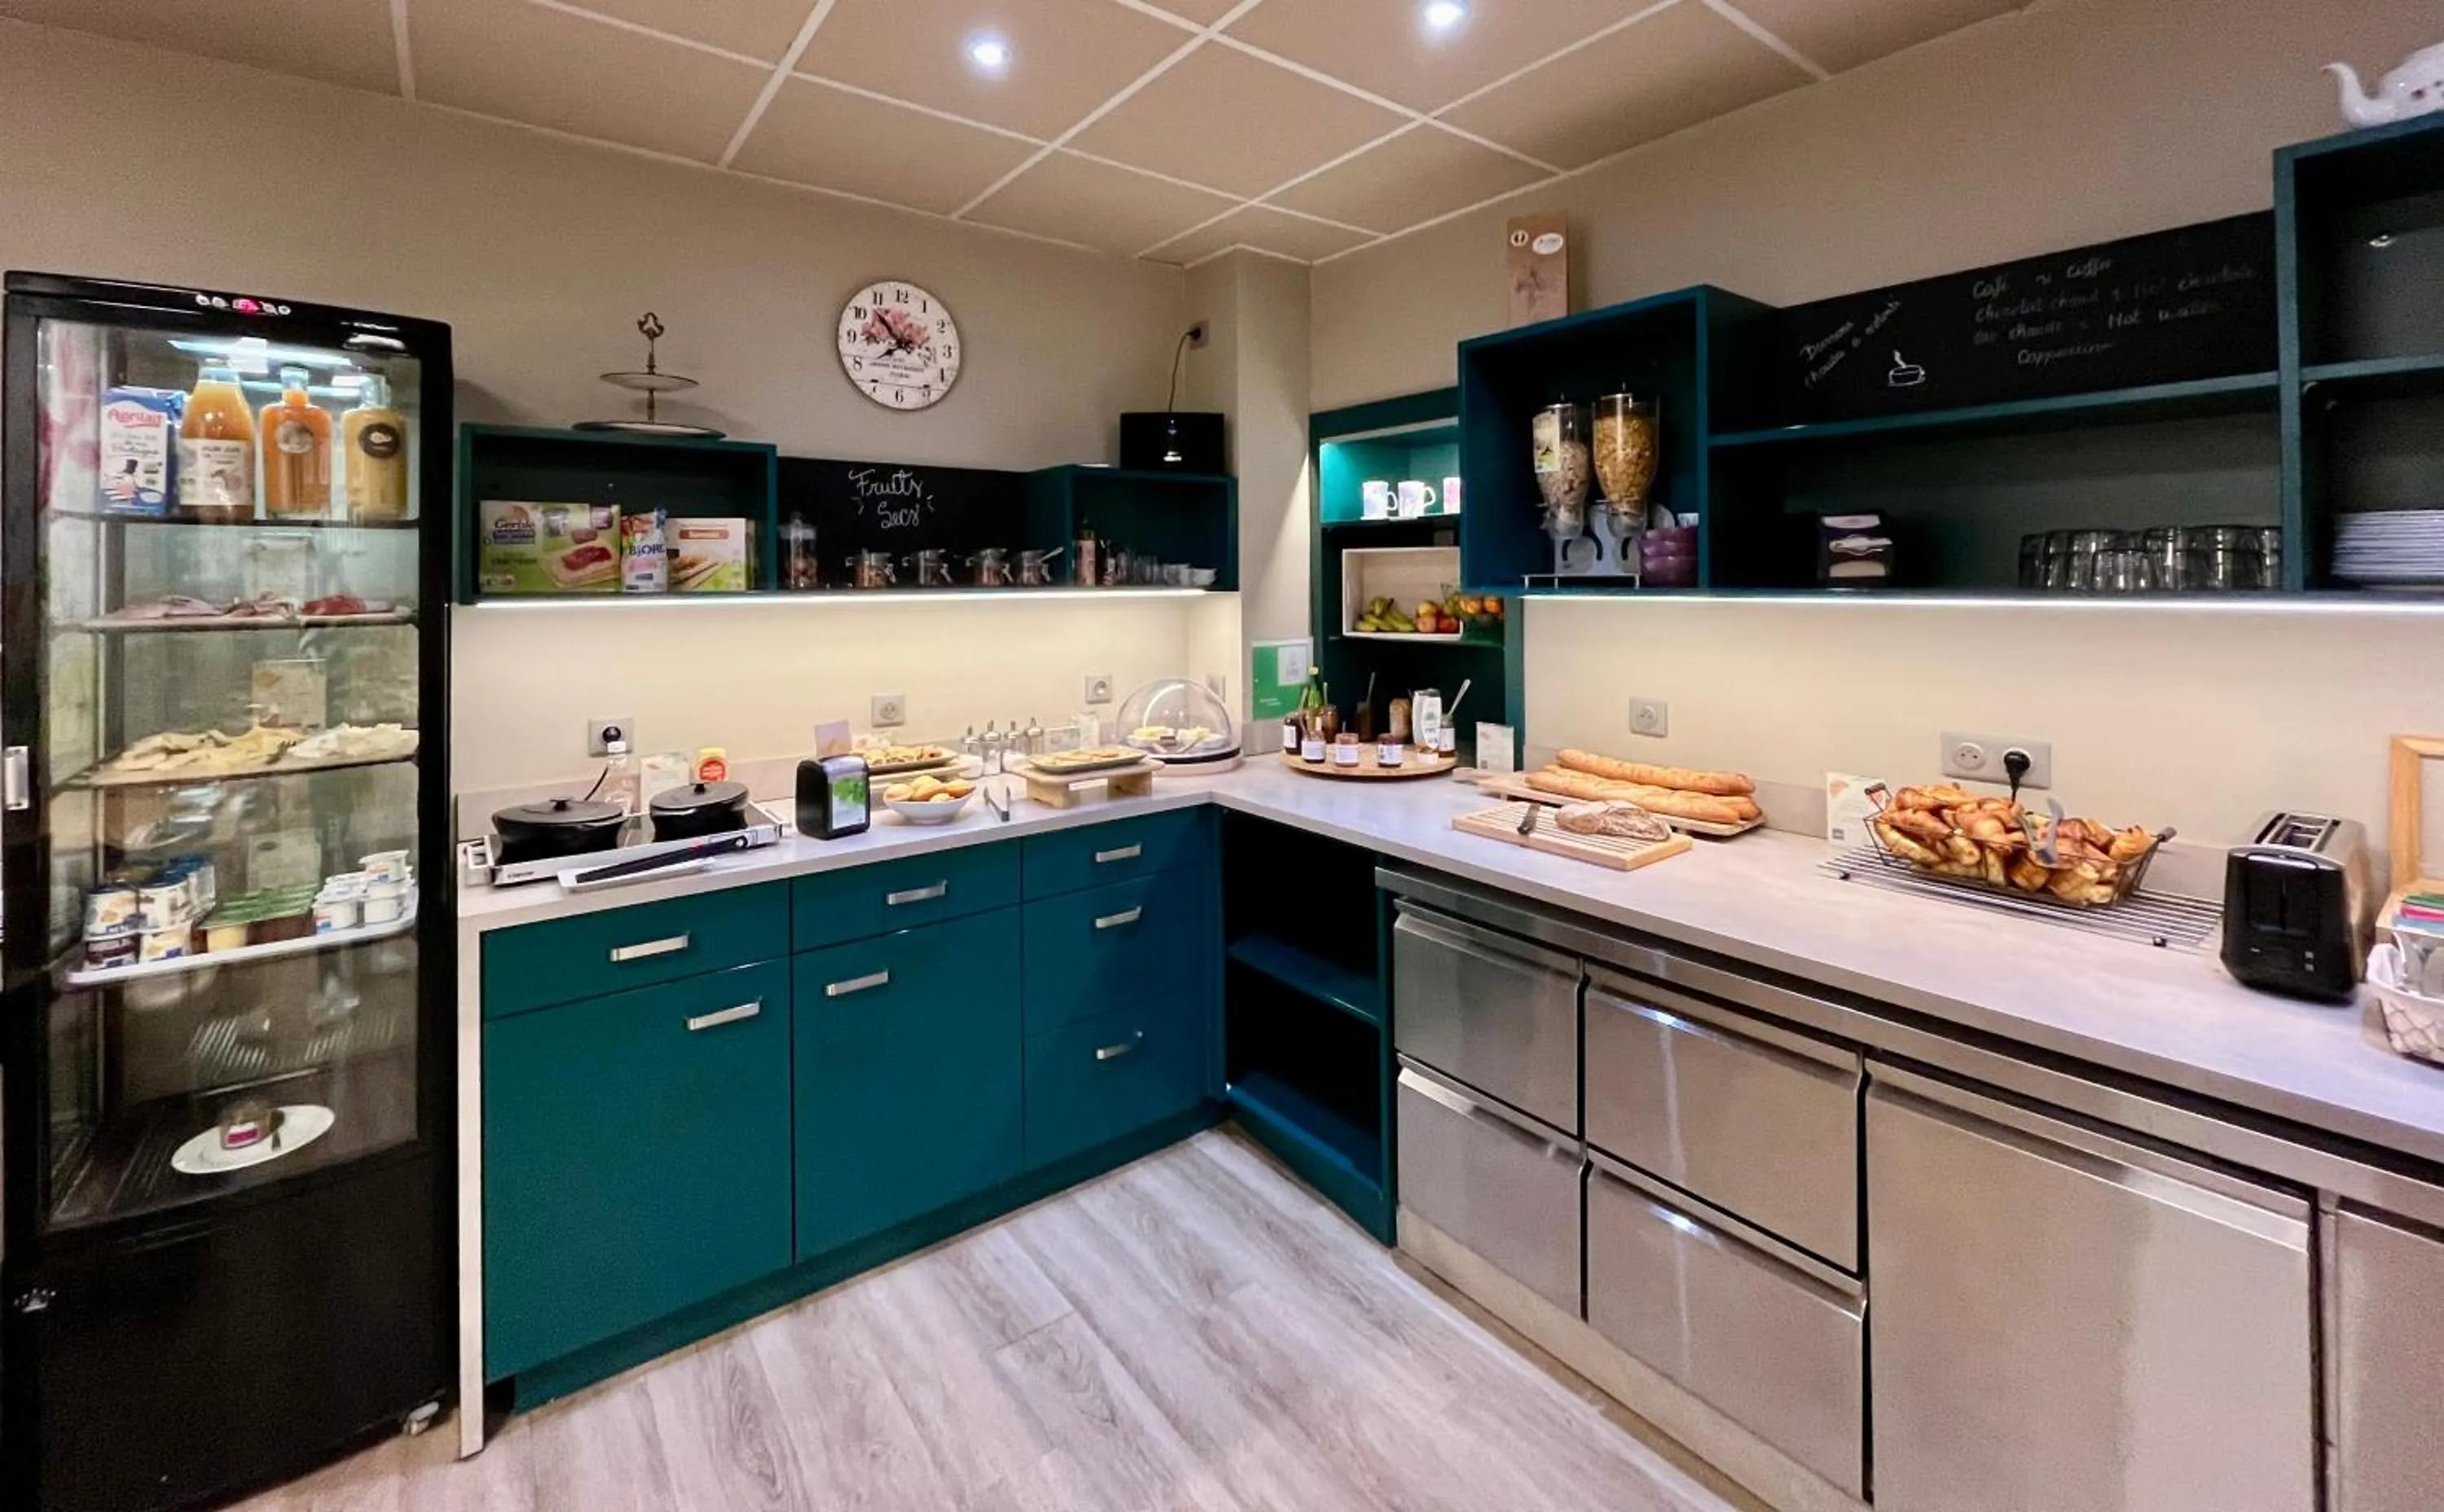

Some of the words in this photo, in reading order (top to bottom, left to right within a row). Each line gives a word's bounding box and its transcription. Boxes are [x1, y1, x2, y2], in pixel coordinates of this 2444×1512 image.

[873, 292, 883, 305] 11
[896, 289, 909, 304] 12
[850, 306, 868, 320] 10
[921, 300, 927, 314] 1
[937, 319, 946, 334] 2
[846, 328, 856, 344] 9
[943, 344, 952, 359] 3
[853, 357, 863, 371] 8
[895, 389, 903, 403] 6
